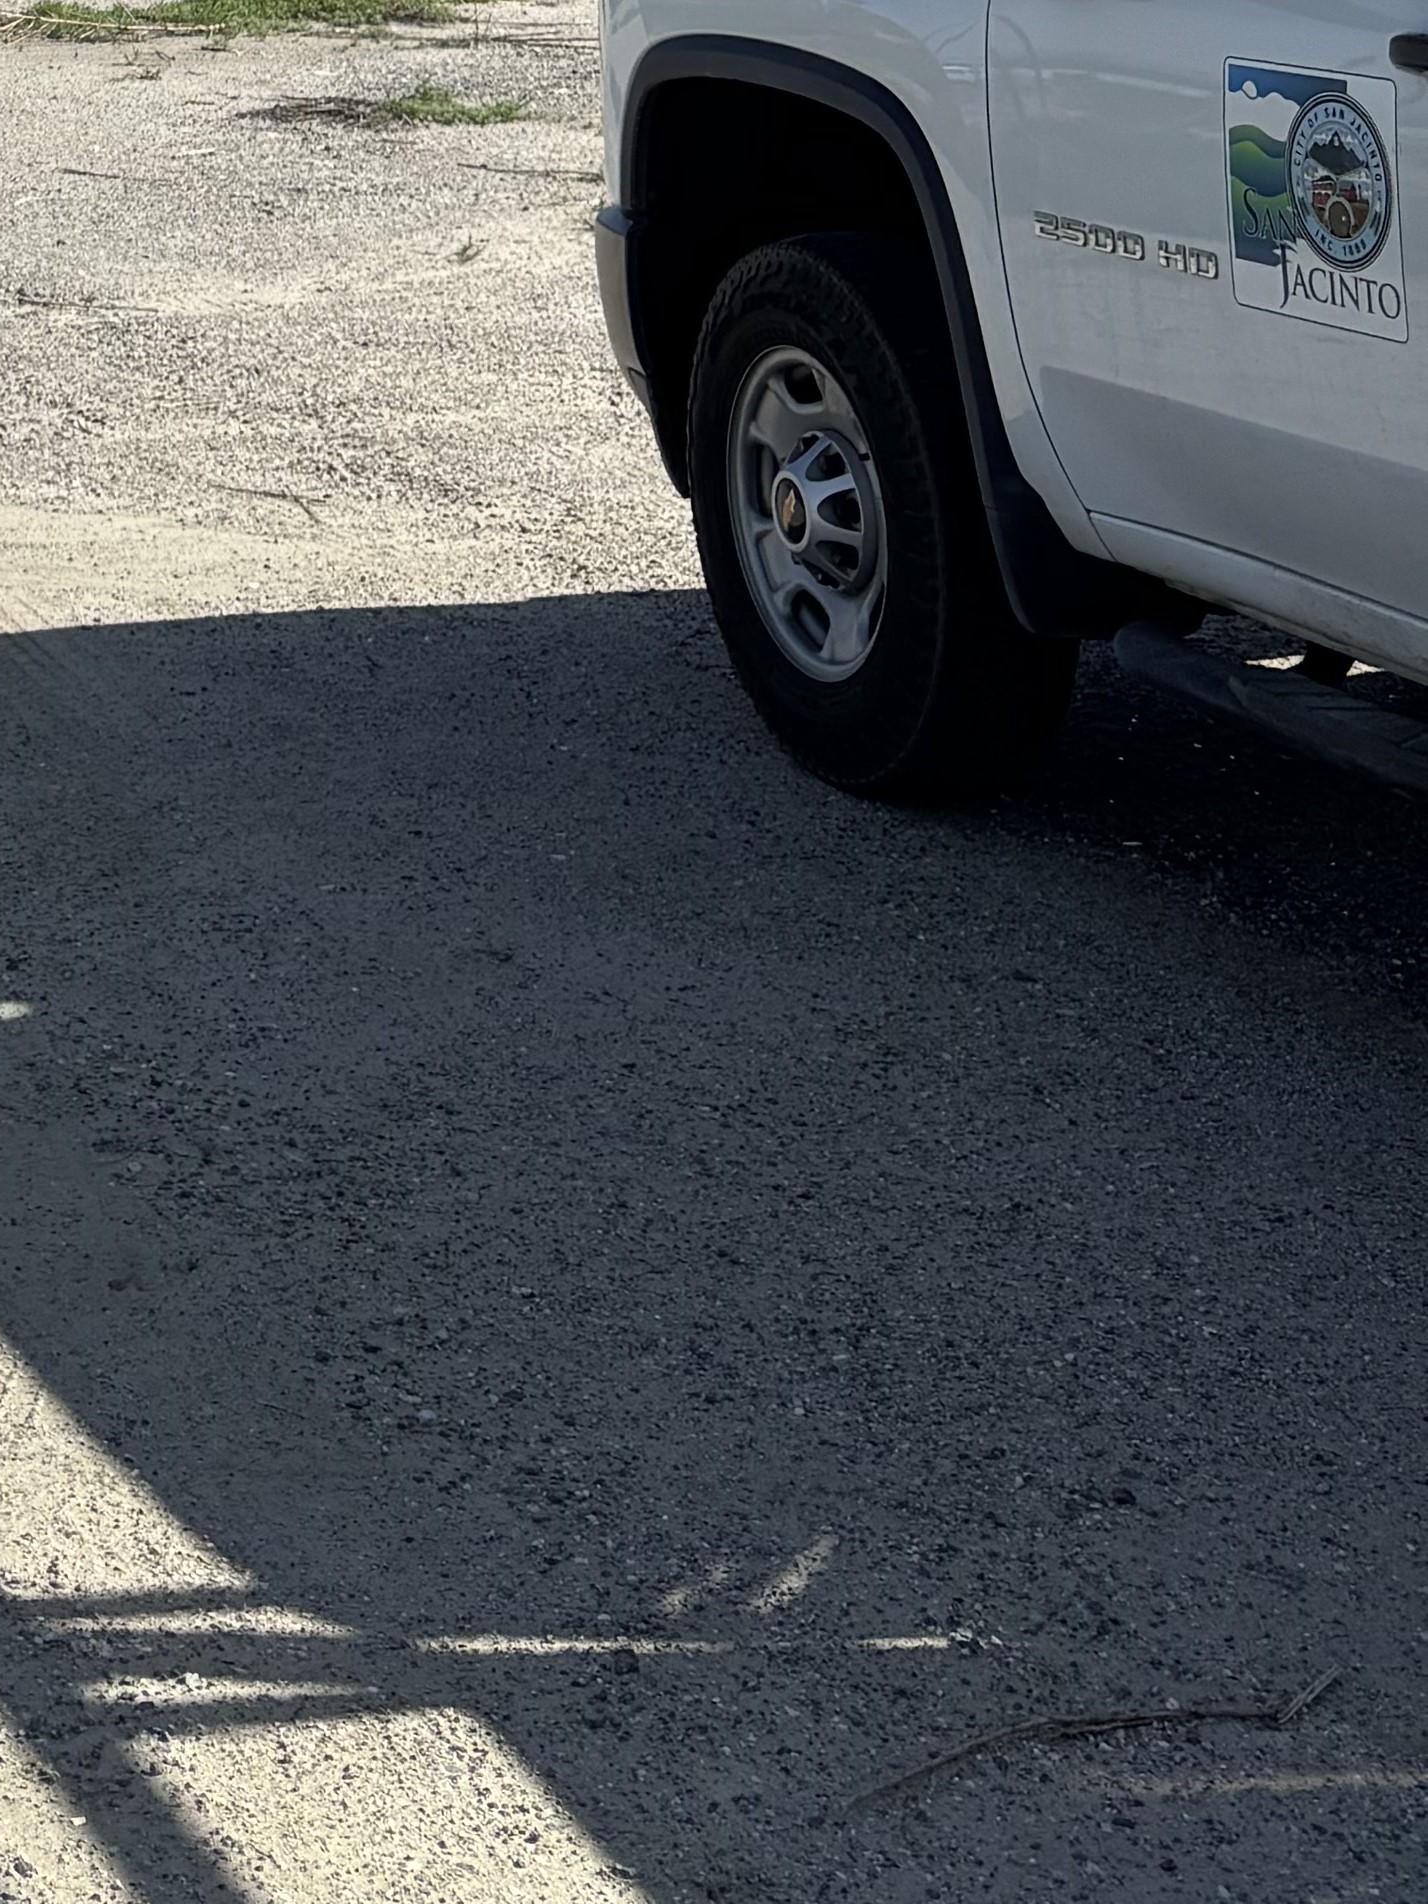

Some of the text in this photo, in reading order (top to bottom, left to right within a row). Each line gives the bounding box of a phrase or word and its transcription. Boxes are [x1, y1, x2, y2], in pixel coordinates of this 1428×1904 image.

[1294, 107, 1383, 182] CITY OF SAN JACINTO
[1033, 210, 1219, 280] 2500 HD
[1279, 243, 1401, 320] JACINTO
